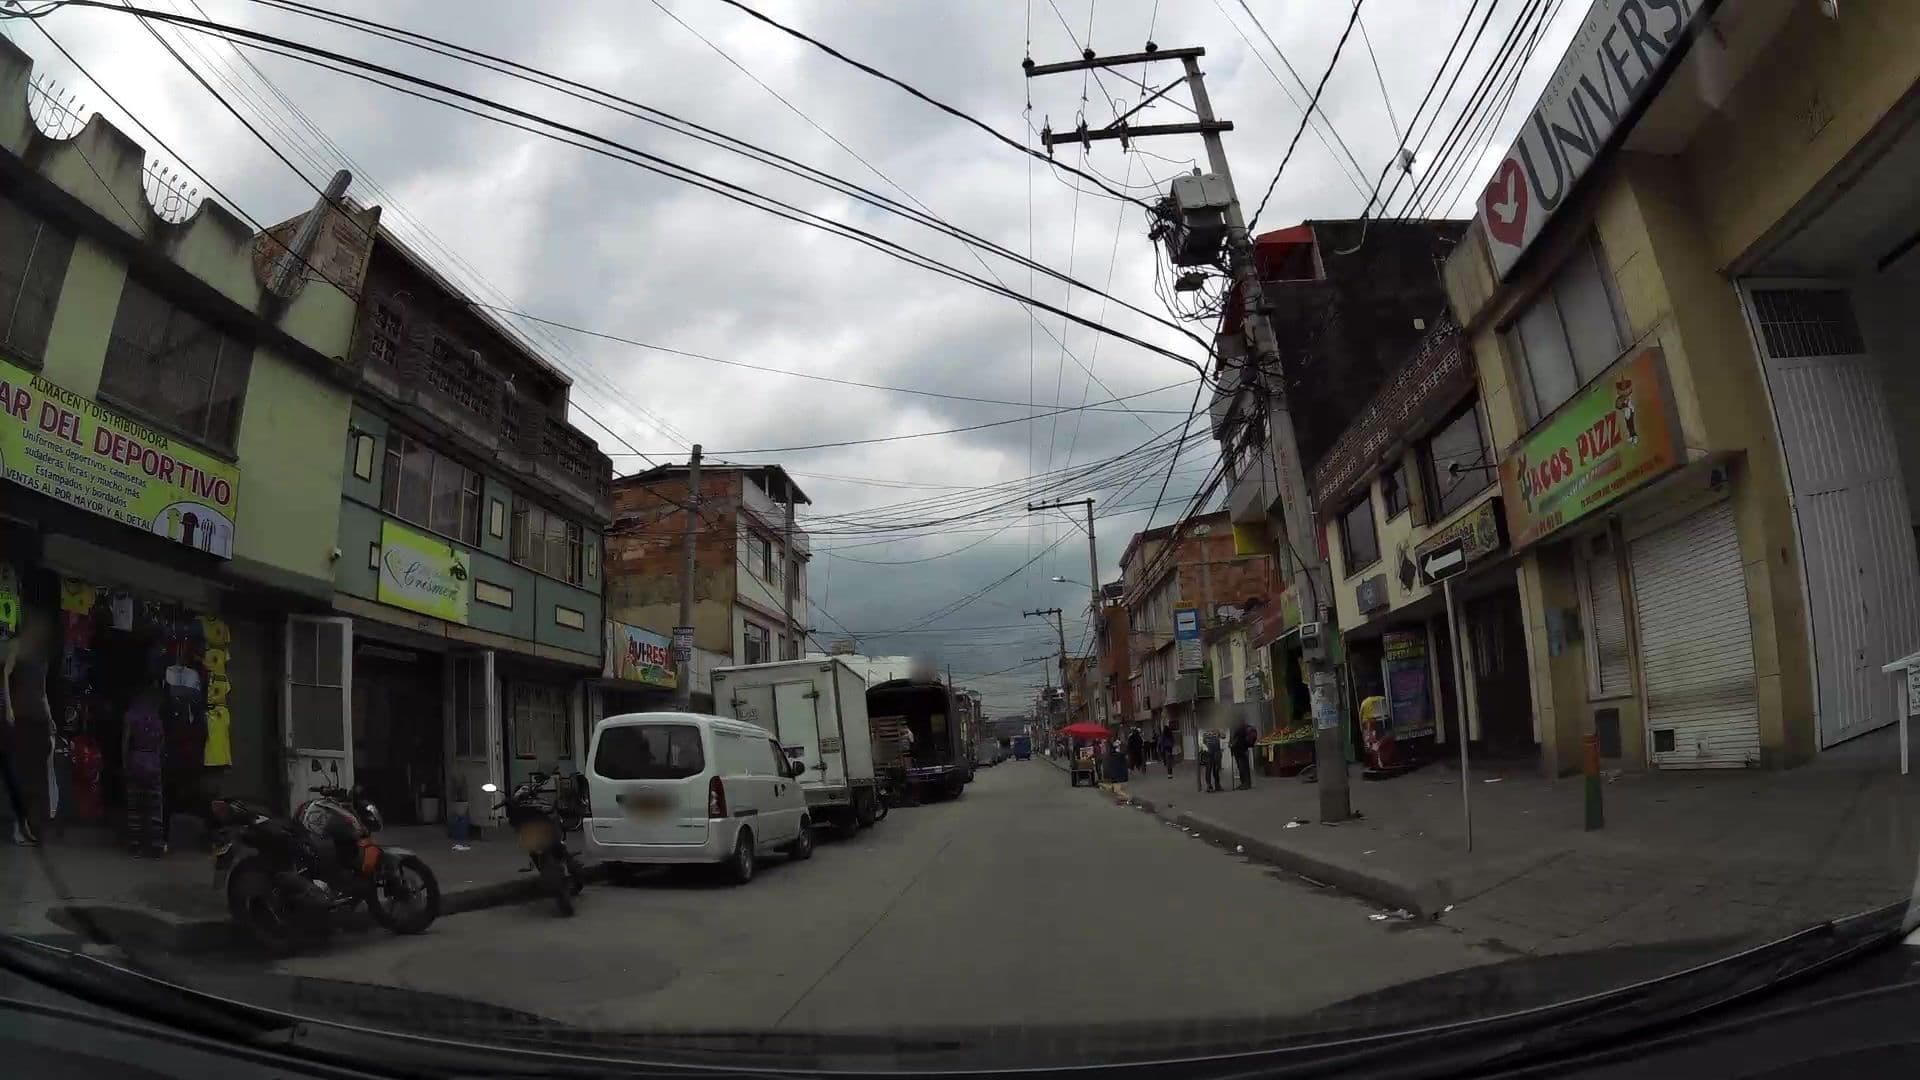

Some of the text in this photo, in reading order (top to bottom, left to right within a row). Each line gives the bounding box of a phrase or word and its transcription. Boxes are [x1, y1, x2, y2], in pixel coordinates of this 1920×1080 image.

[29, 375, 169, 451] ALMACEN Y DISTRIBUIDORA
[22, 427, 64, 454] Uniformes
[39, 400, 84, 447] DEL
[93, 425, 232, 506] DEPORTIVO
[6, 468, 40, 490] VENTAS
[42, 482, 53, 494] AL
[54, 487, 72, 502] POR
[73, 494, 104, 513] MAYOR
[104, 506, 112, 516] Y
[113, 509, 125, 521] AL
[35, 464, 84, 492] Estampados
[85, 484, 91, 496] y
[89, 470, 96, 483] y
